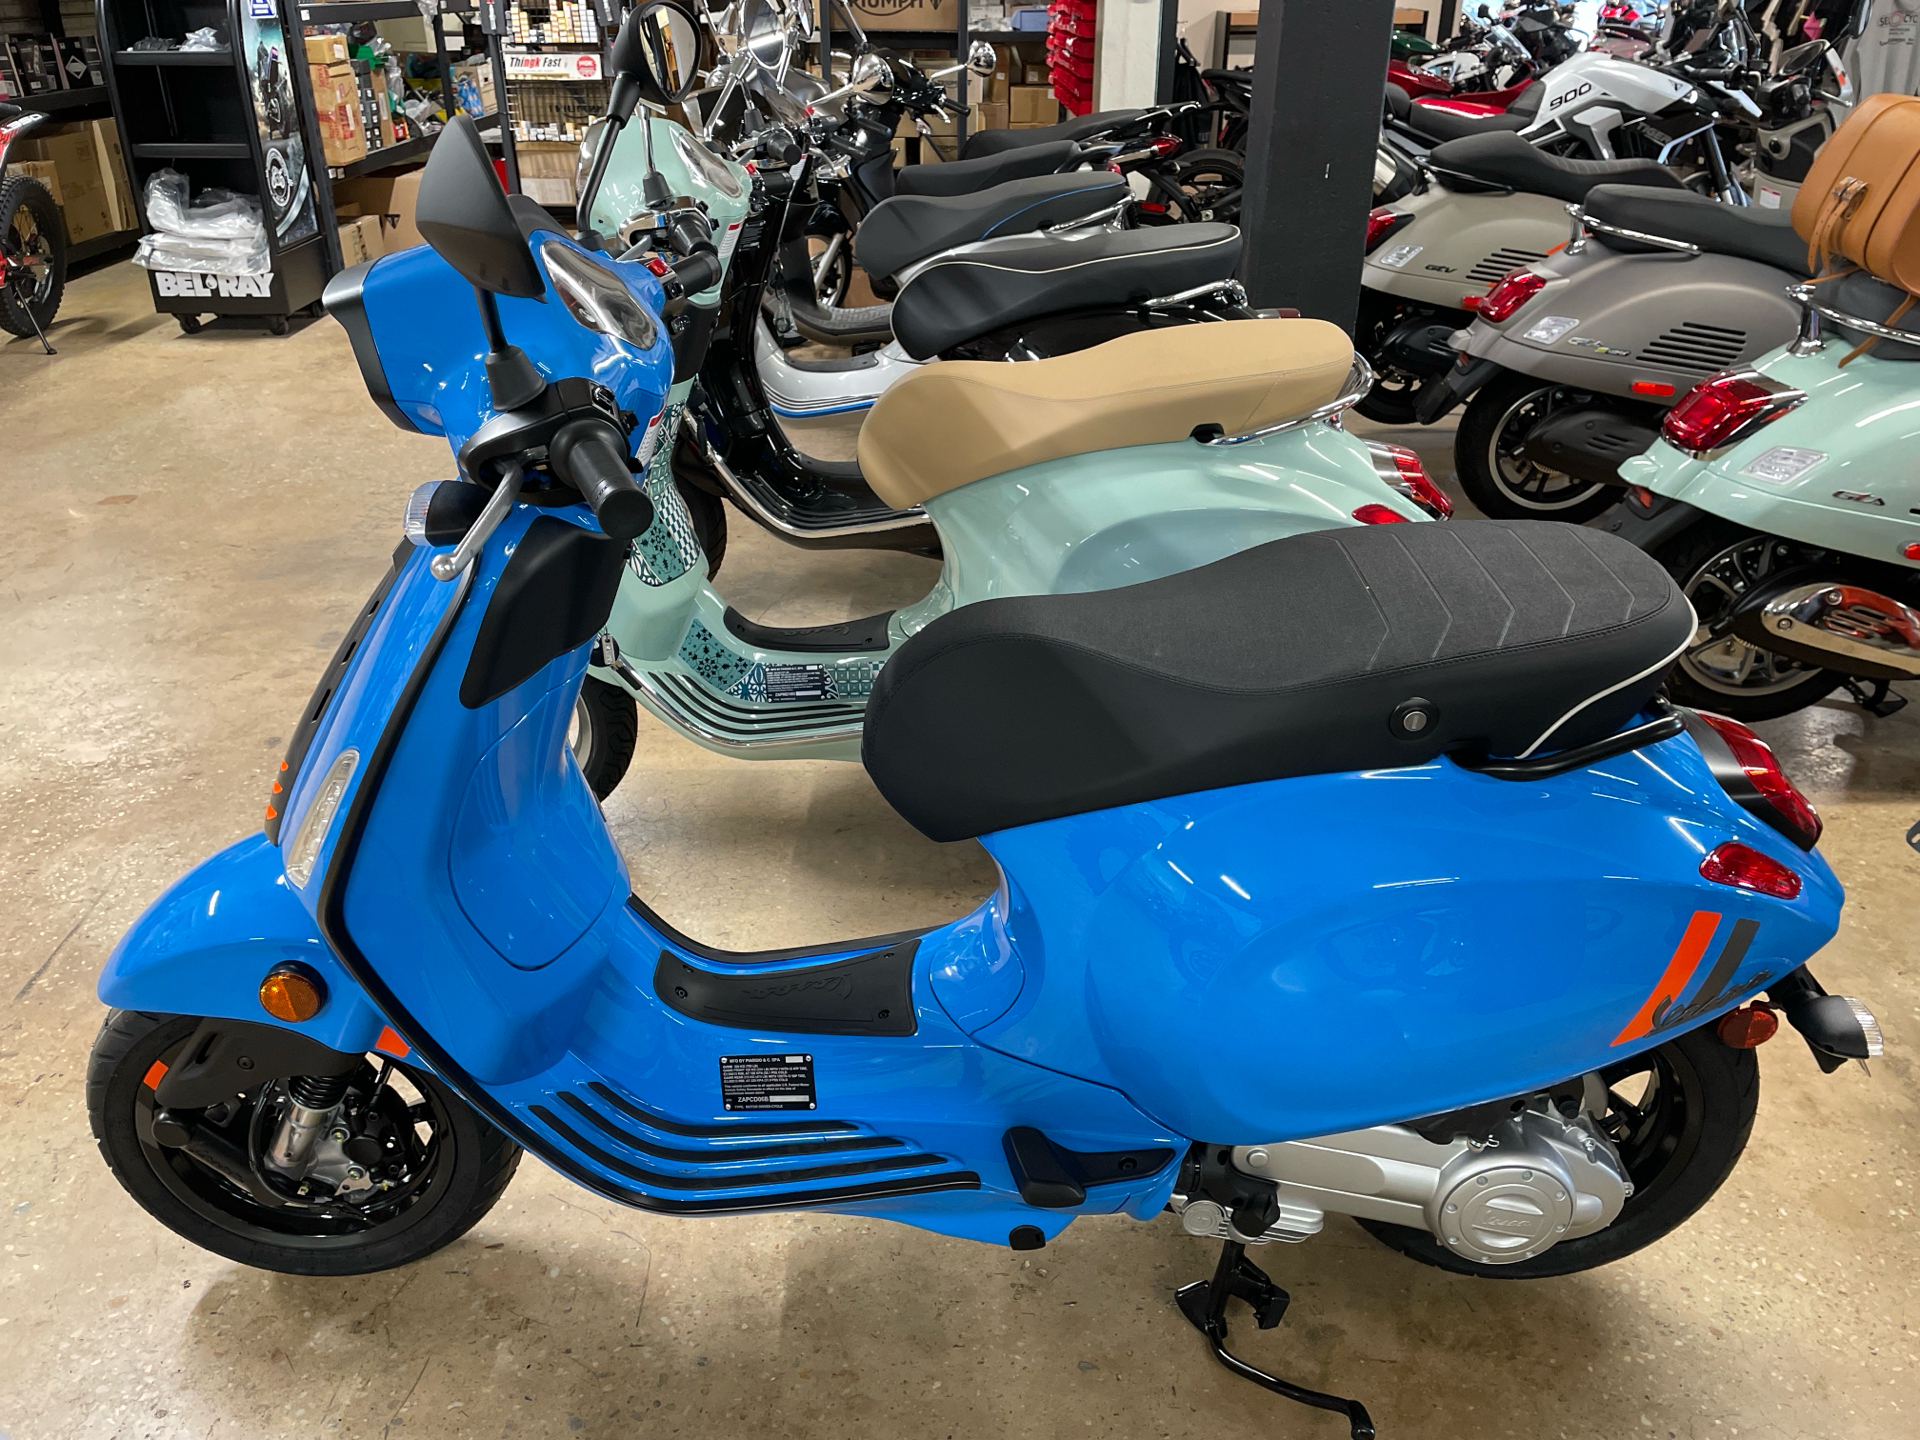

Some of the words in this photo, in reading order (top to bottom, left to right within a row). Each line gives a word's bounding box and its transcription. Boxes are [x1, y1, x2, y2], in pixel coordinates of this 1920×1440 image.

[509, 56, 540, 69] Thingk
[542, 57, 562, 68] Fast
[1549, 82, 1592, 111] 900
[1637, 121, 1673, 145] TIGER
[1482, 1209, 1532, 1227] Vespa
